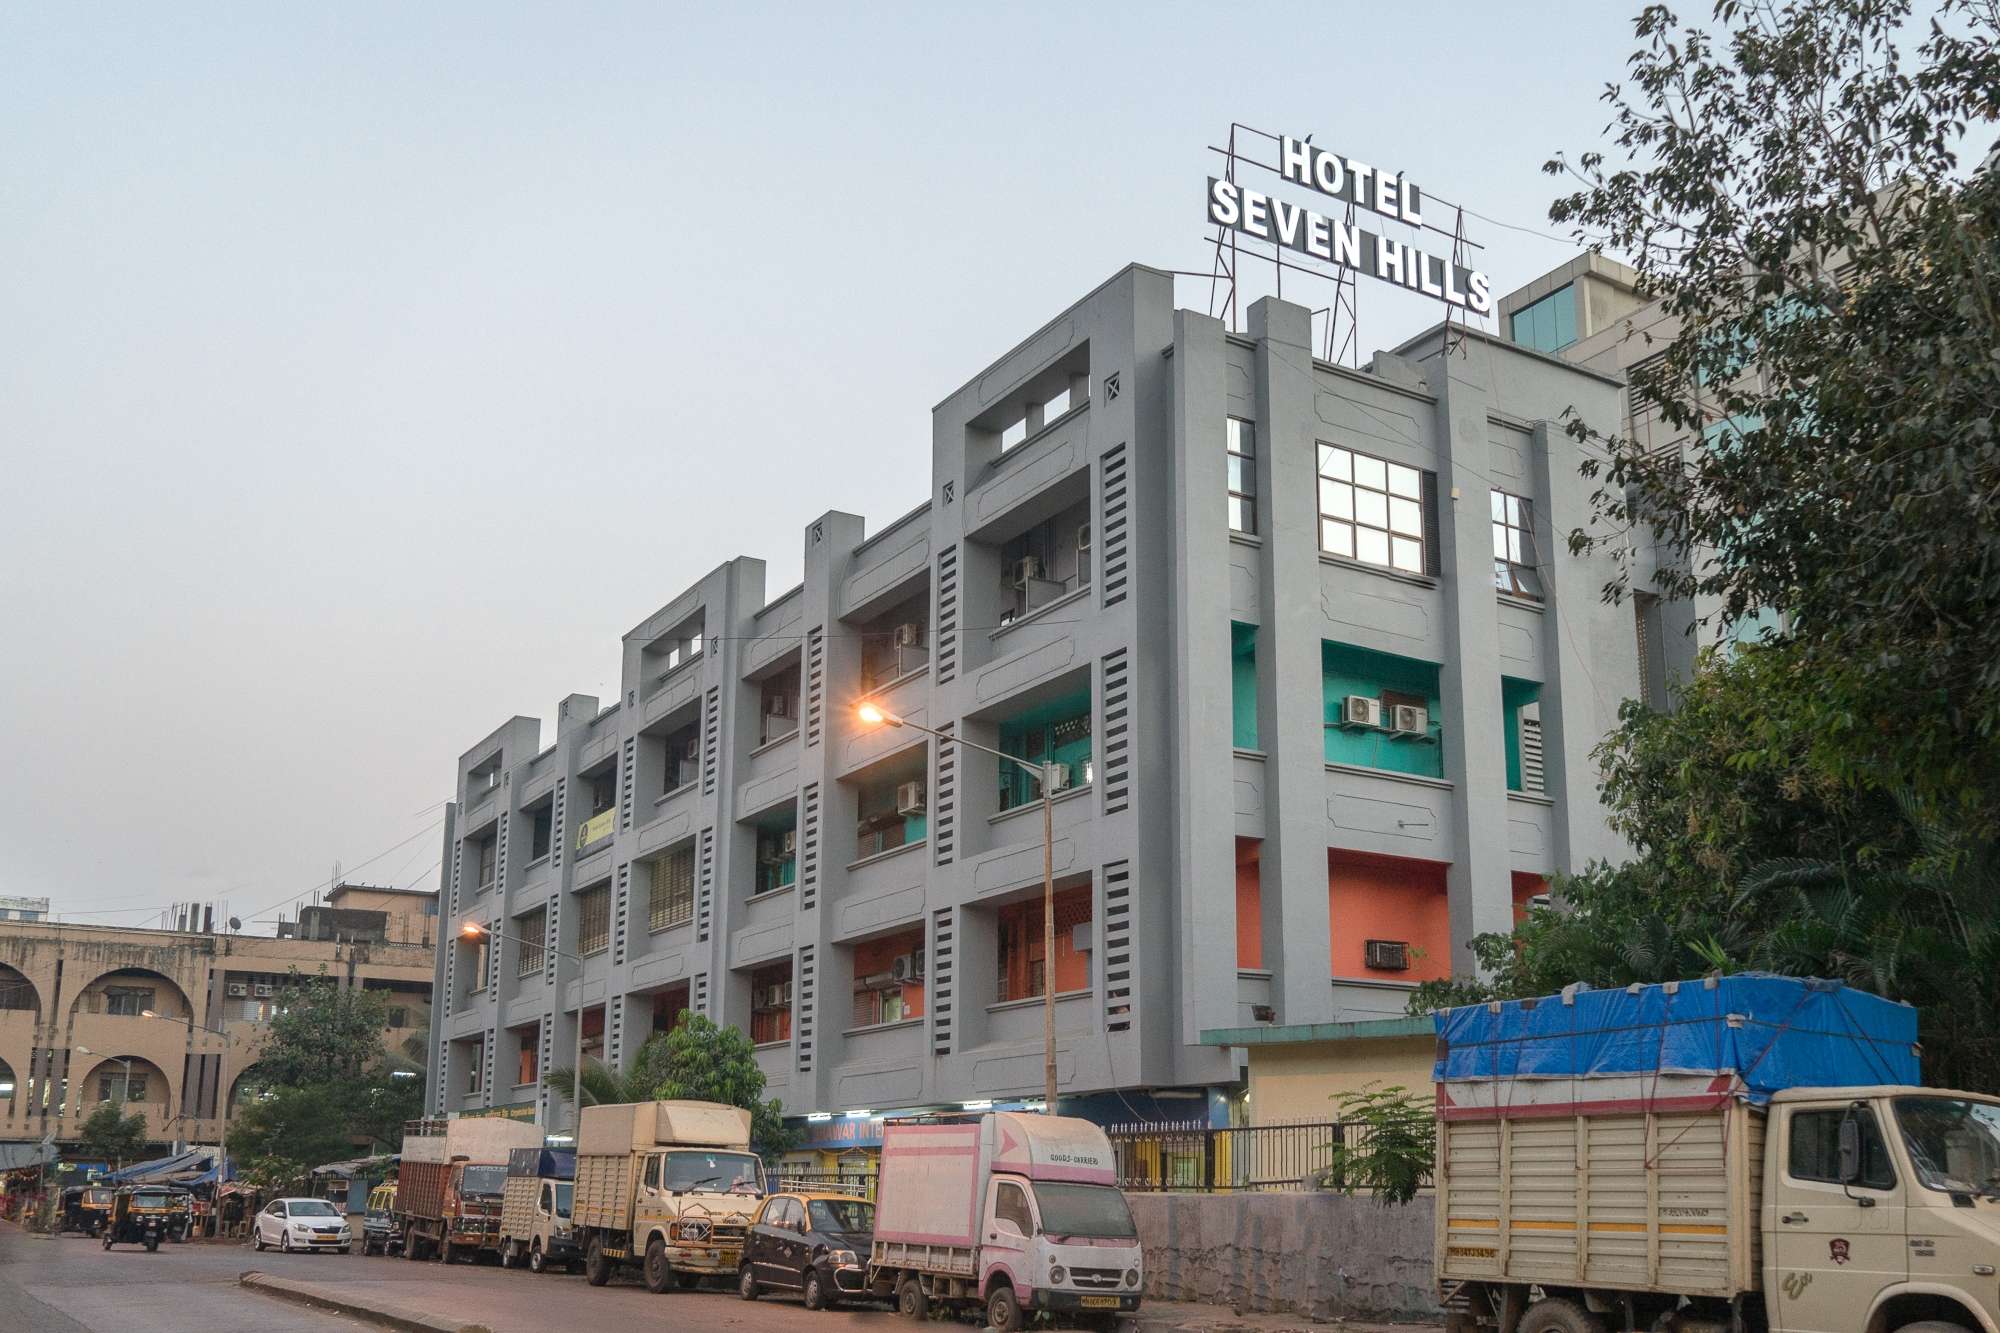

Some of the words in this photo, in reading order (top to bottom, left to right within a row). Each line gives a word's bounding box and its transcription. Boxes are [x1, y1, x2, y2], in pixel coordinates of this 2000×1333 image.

[1281, 135, 1422, 226] HOTEL
[1209, 179, 1360, 268] SEVEN
[1377, 235, 1491, 312] HILLS
